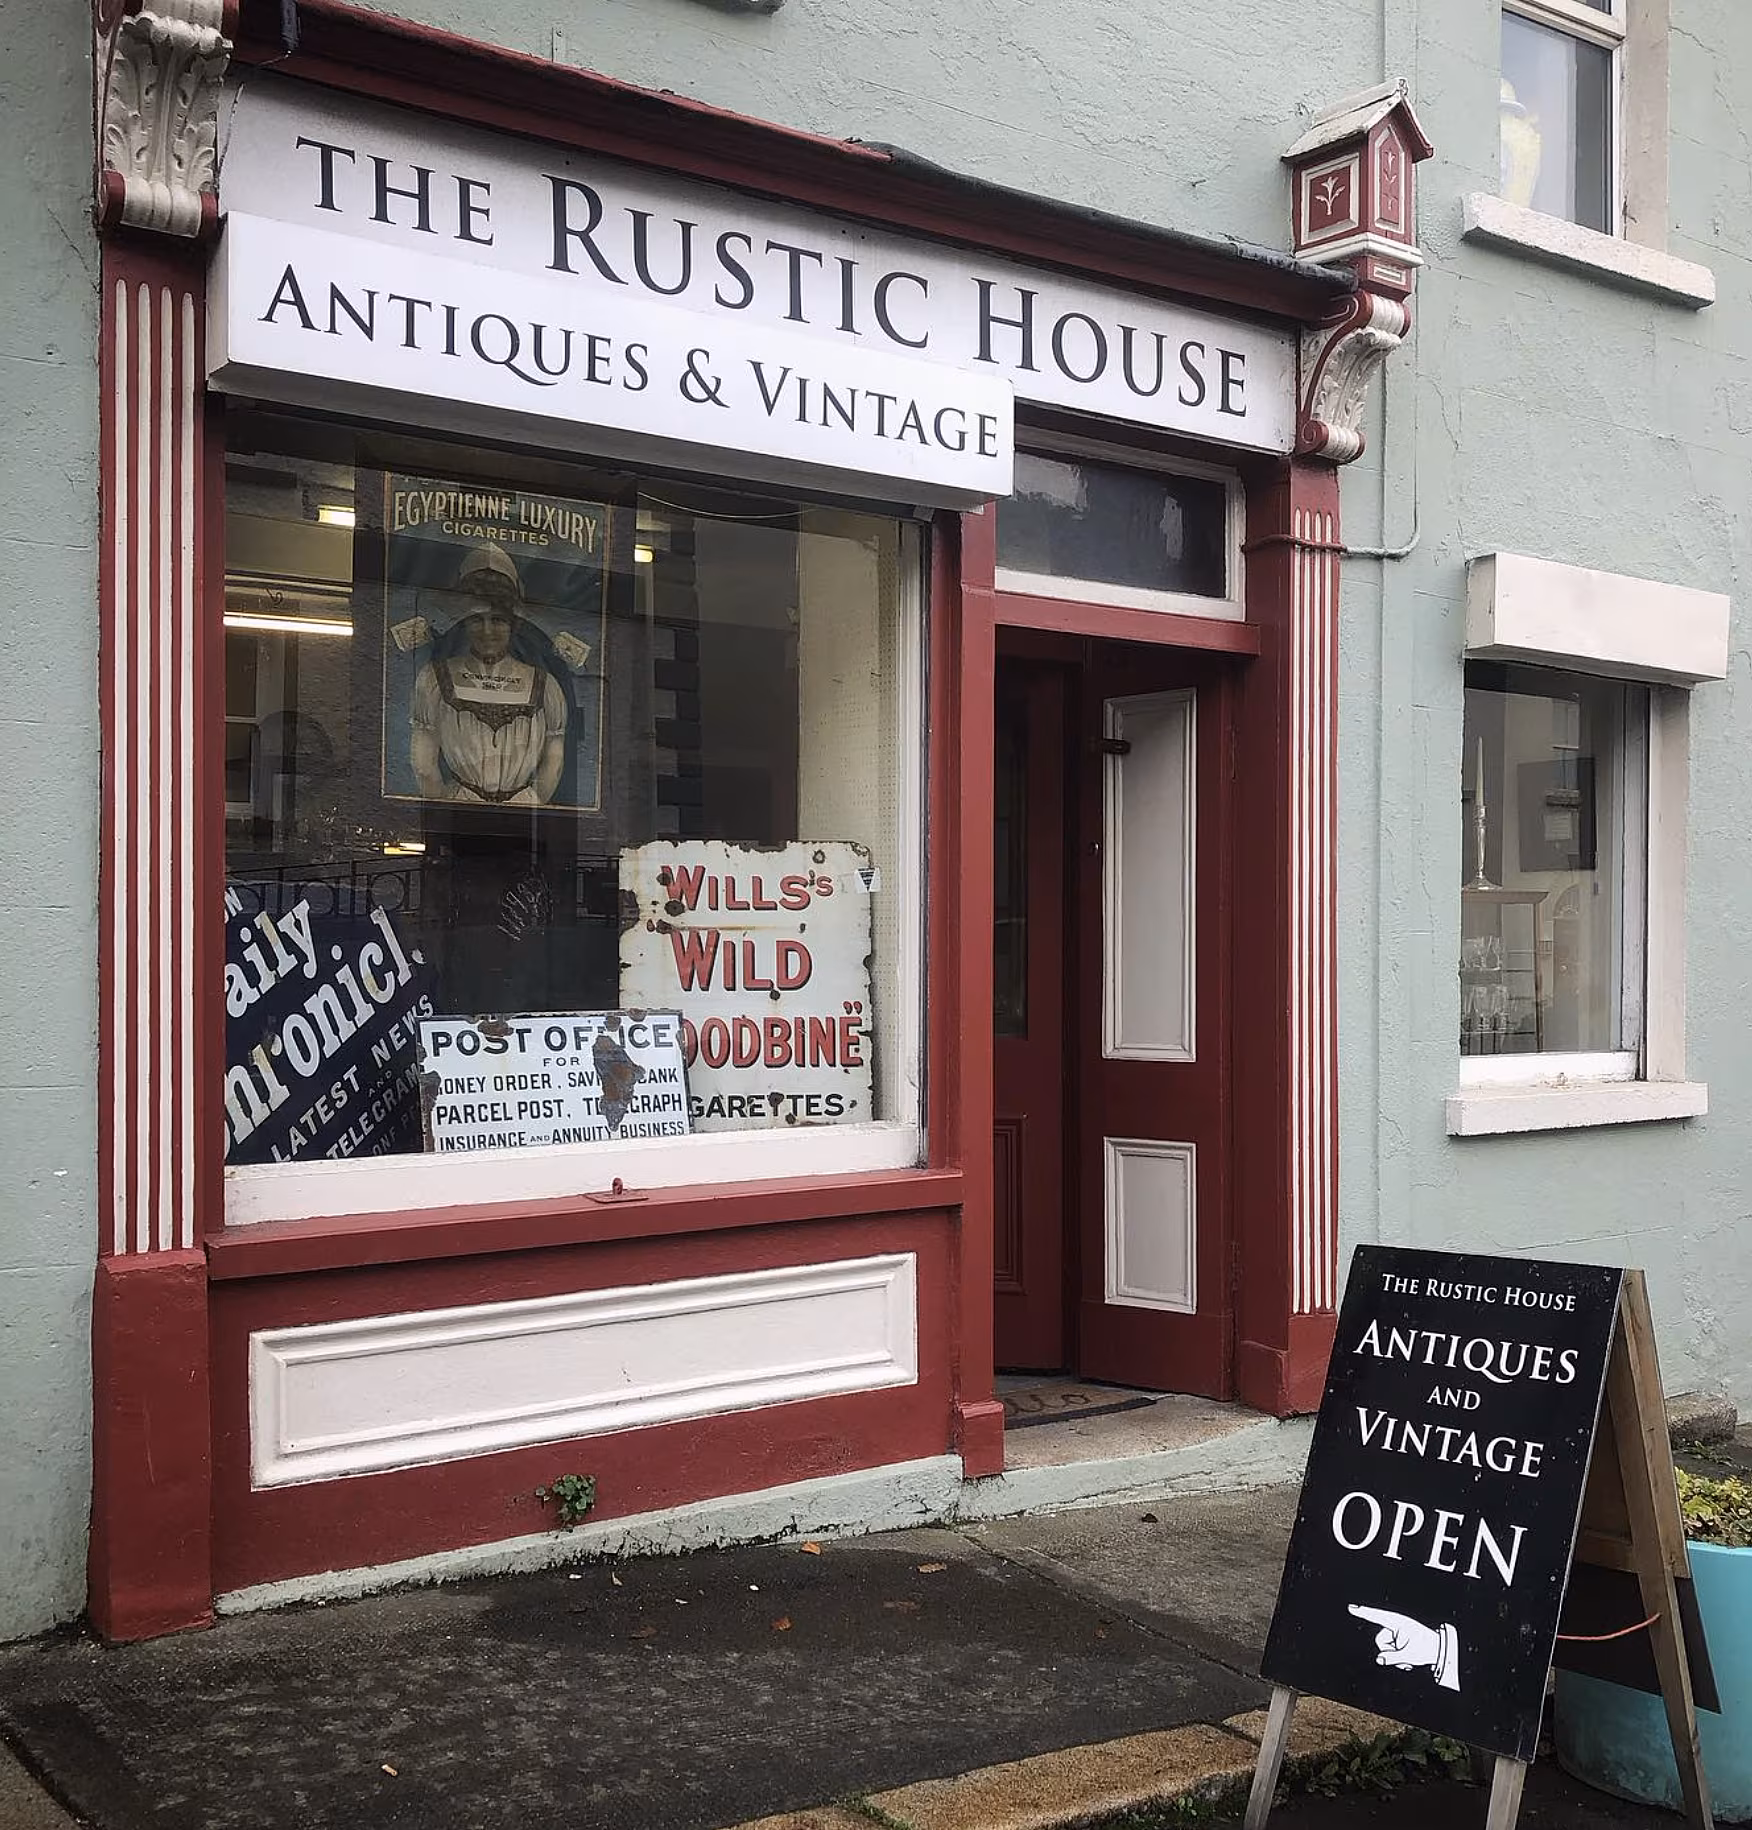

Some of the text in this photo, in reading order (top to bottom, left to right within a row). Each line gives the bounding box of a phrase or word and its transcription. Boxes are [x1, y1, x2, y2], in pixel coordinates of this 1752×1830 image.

[296, 136, 1248, 418] THE RUSTIC HOUSE
[258, 263, 999, 459] ANTIQUES & VINTAGE
[393, 490, 597, 554] EGYPTIENNE LUXURY
[442, 520, 549, 547] CIGARETTES
[225, 898, 318, 1018] aily
[670, 928, 813, 992] WILD
[431, 1028, 532, 1057] POST
[543, 1056, 580, 1067] FOR
[271, 994, 434, 1163] LATEST NEWS
[439, 1076, 486, 1095] ONEY
[325, 1062, 420, 1160] TELEGRAM
[436, 1101, 513, 1126] PARCEL
[440, 1120, 685, 1151] INSURANCE AND ANNUITY BUSINESS
[1382, 1273, 1577, 1312] THE RUSTIC HOUSE
[1353, 1318, 1580, 1385] ANTIQUES
[1426, 1384, 1482, 1411] AND
[1355, 1406, 1545, 1479] VINTAGE
[1331, 1491, 1529, 1588] OPEN
